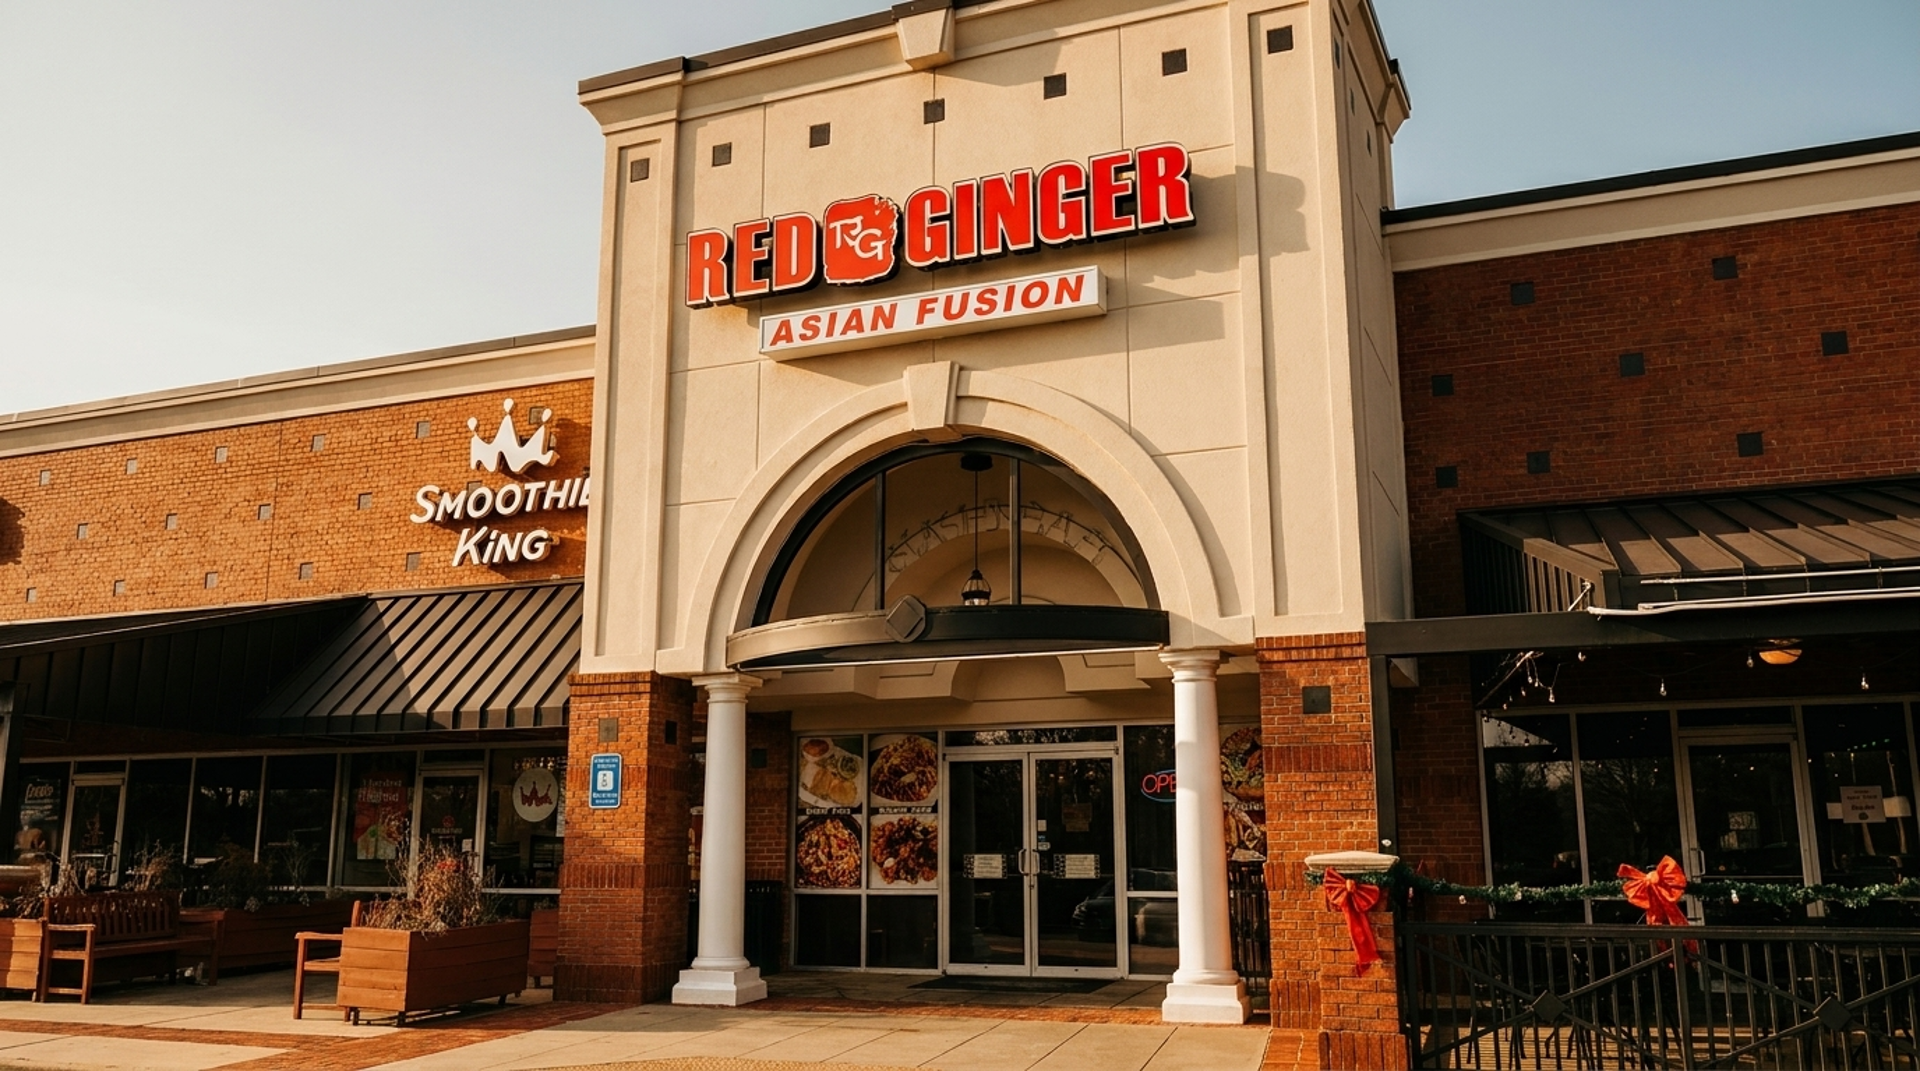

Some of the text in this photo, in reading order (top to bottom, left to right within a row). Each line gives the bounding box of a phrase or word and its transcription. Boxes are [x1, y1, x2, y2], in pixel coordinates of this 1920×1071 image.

[686, 211, 819, 305] RED
[904, 141, 1195, 267] GINGER
[769, 274, 1085, 346] ASIAN FUSION
[1142, 773, 1176, 794] OPE
